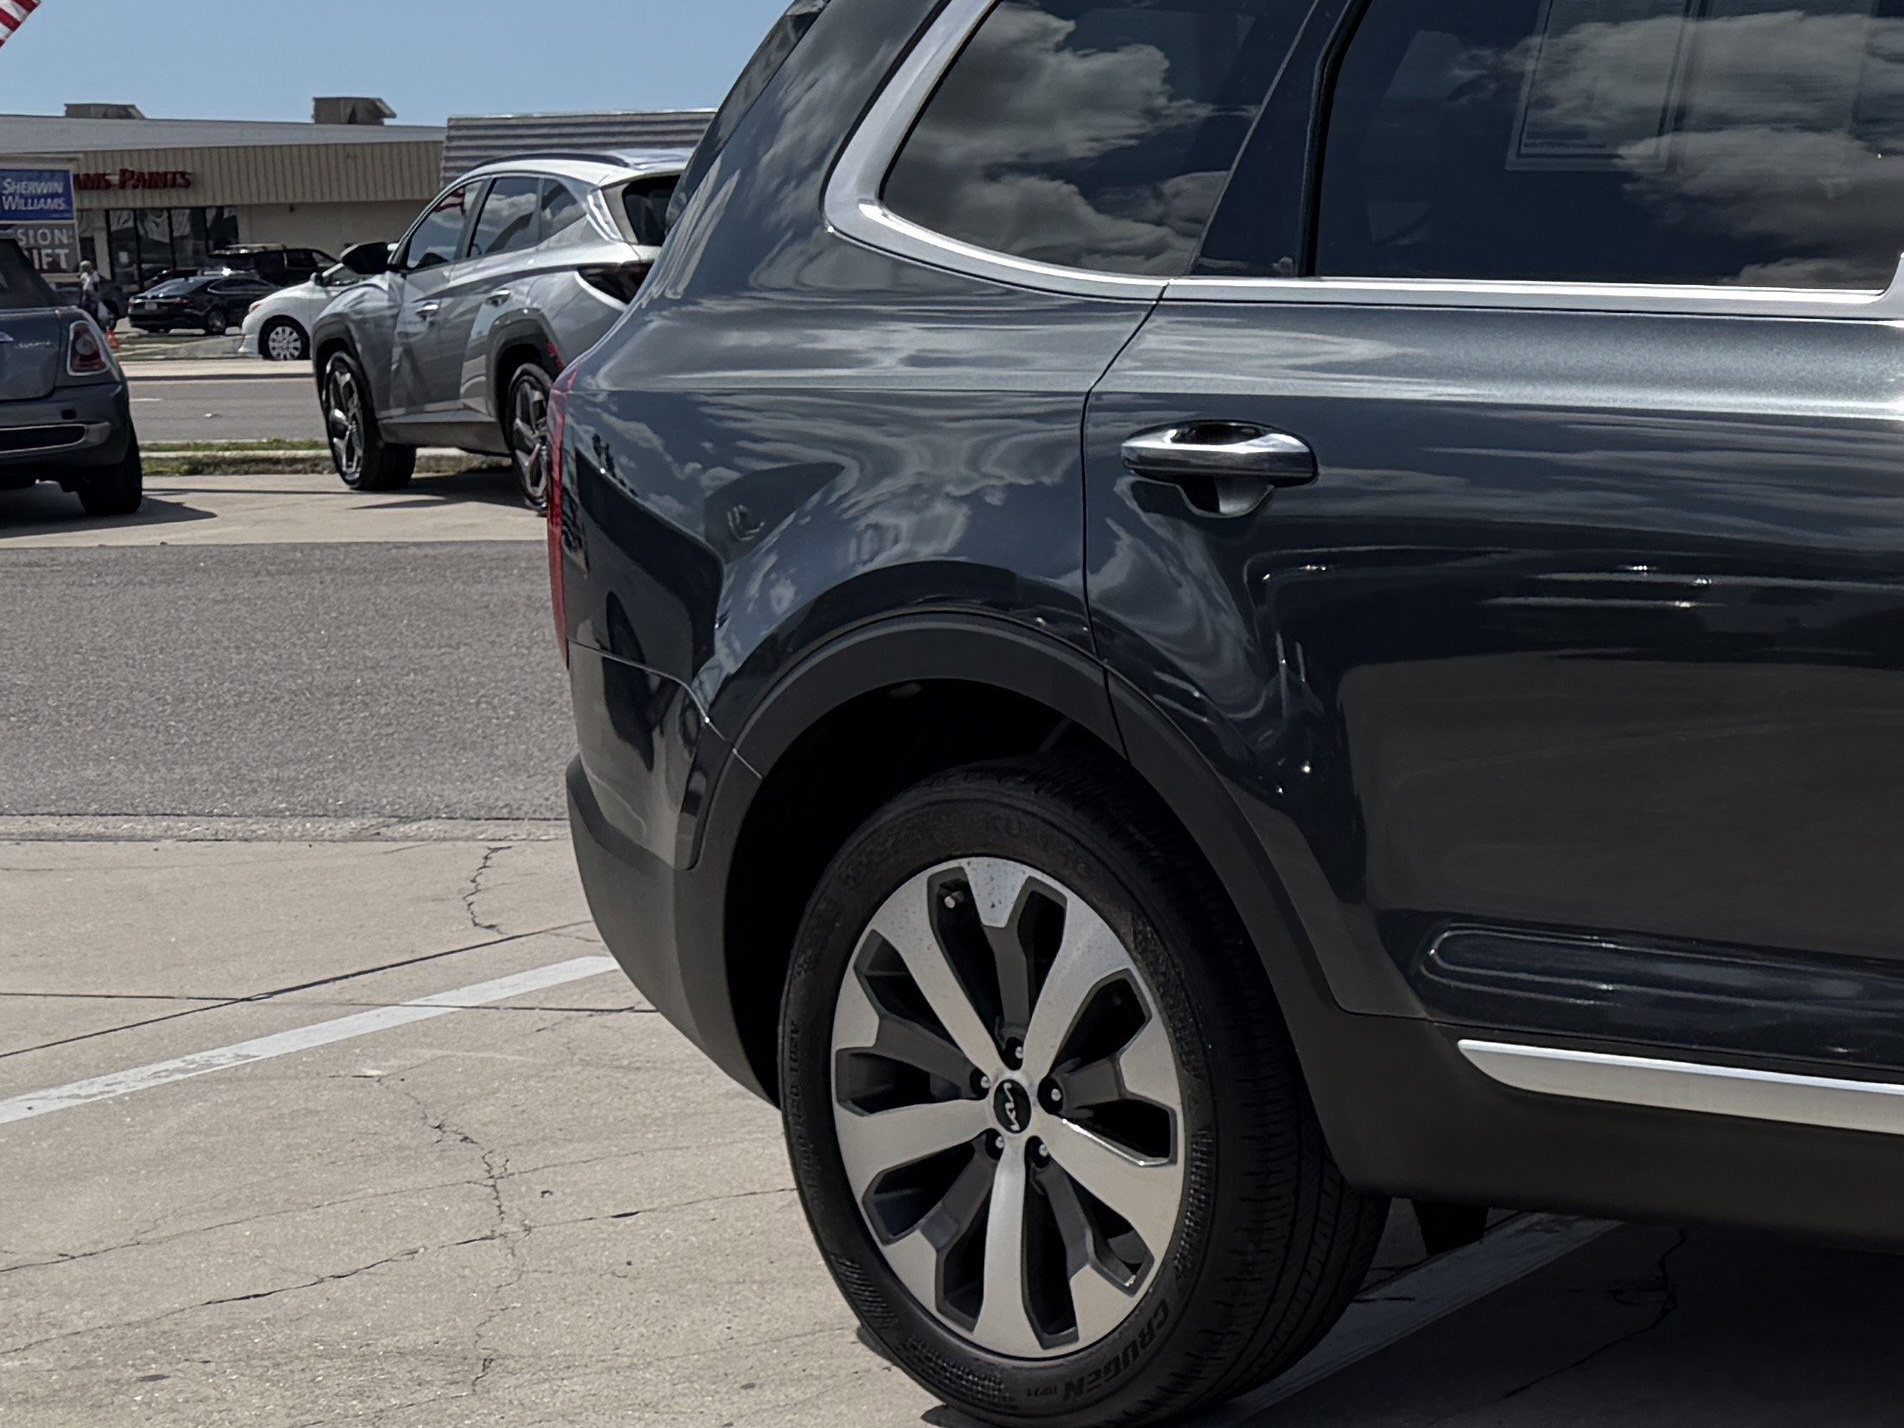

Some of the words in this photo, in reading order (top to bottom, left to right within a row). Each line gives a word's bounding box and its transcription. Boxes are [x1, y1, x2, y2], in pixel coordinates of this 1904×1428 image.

[2, 178, 63, 194] SHERWIN
[2, 194, 67, 210] WILLIAMS
[1062, 1298, 1170, 1401] CRUGEN
